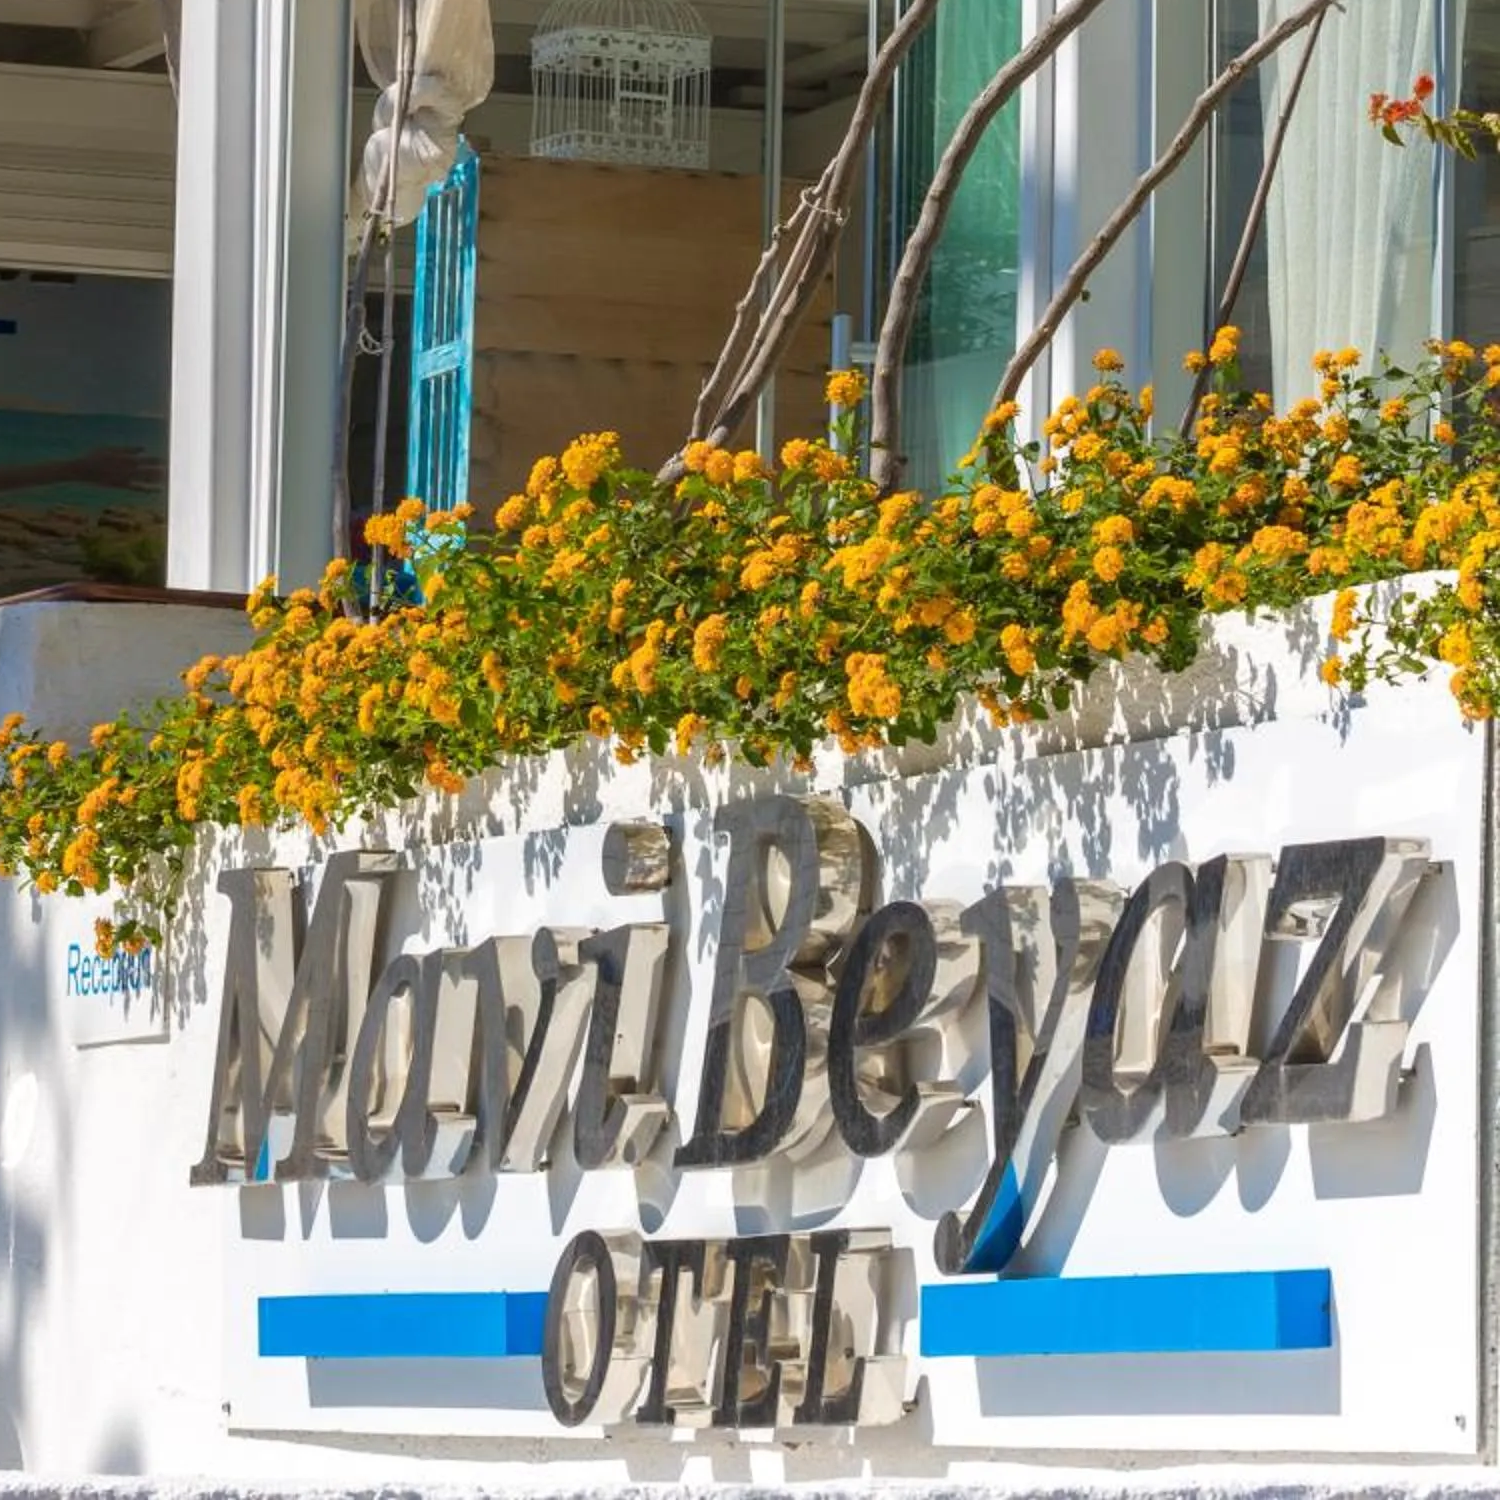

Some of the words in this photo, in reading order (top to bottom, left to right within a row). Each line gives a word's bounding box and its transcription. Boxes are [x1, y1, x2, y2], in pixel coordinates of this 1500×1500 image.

[190, 820, 676, 1186] Mavi
[674, 792, 1432, 1275] Beyaz
[541, 1227, 908, 1429] OTEL
